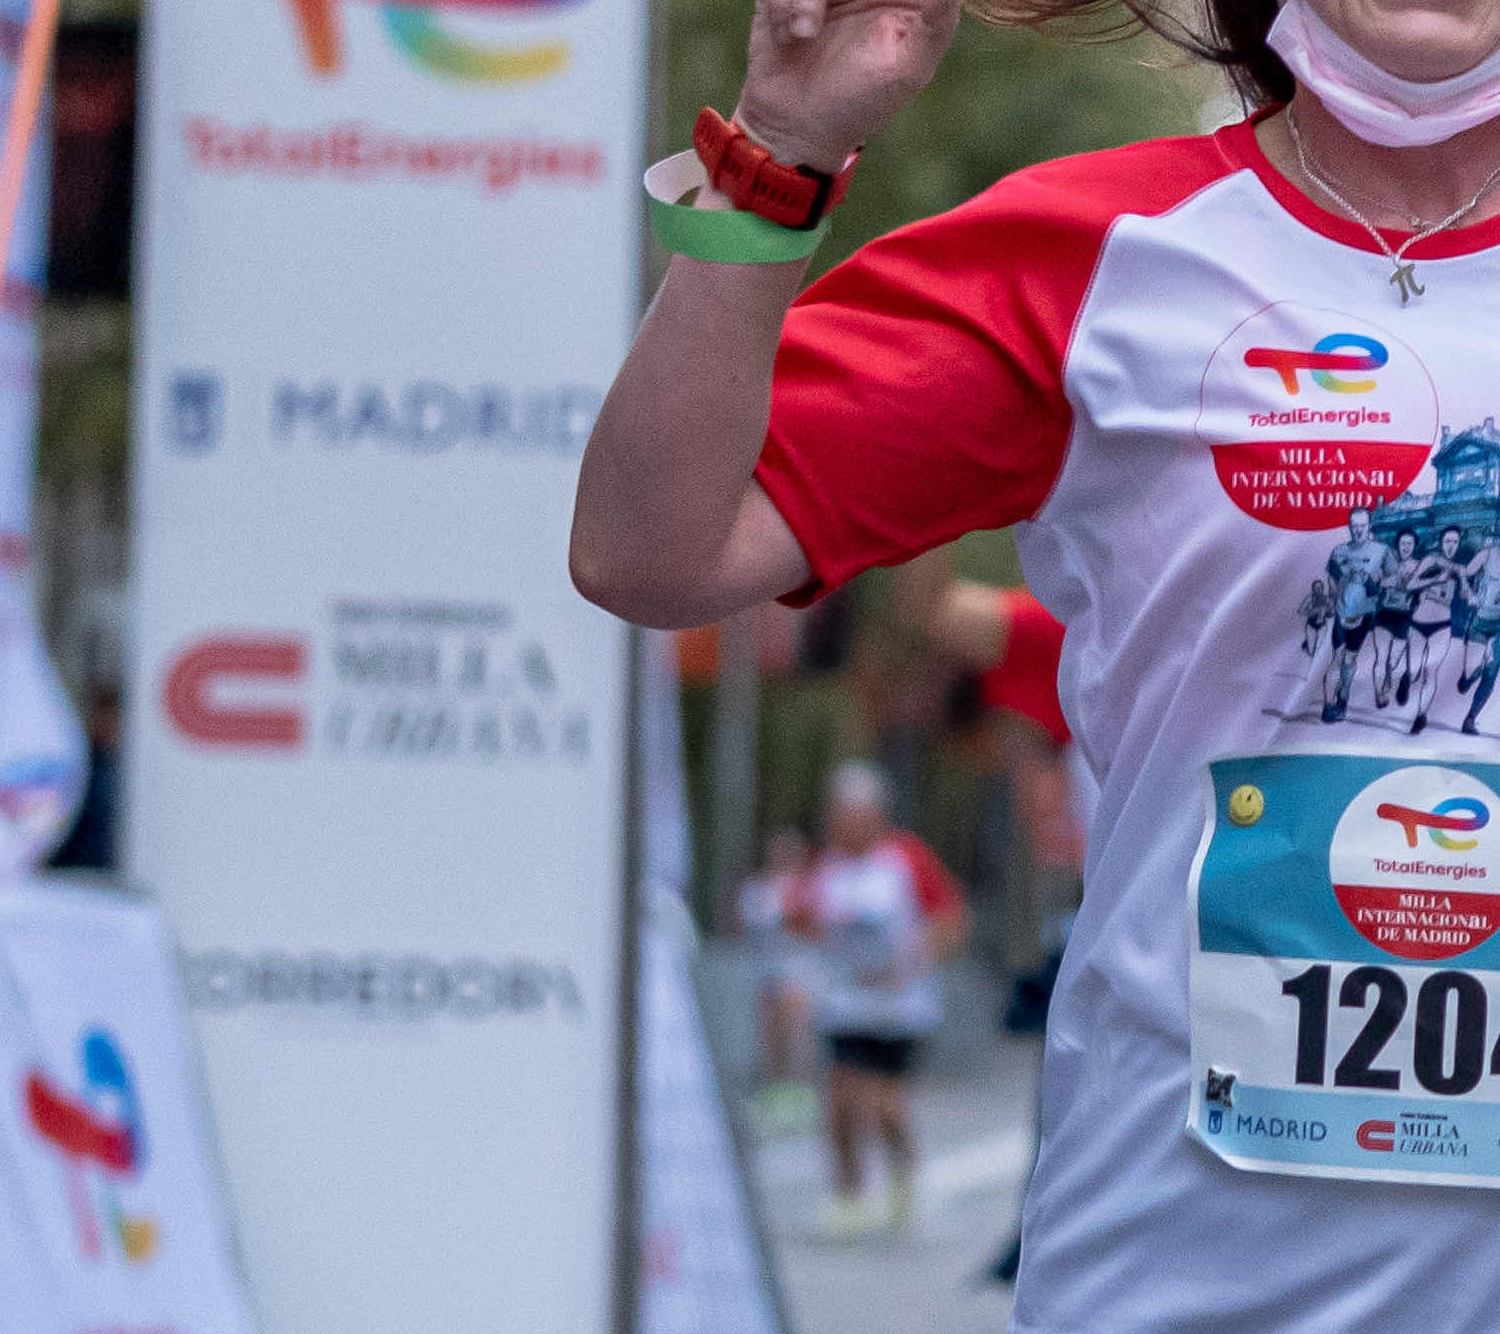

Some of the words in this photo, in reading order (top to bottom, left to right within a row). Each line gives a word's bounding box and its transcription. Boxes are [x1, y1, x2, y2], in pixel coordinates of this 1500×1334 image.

[184, 116, 605, 198] TotalEnergies
[1249, 407, 1392, 428] TotalEnergies
[1280, 447, 1346, 465] MILLA
[1252, 492, 1281, 509] DE
[1287, 490, 1373, 508] MADRID
[1374, 858, 1488, 881] TotalEnergies
[1399, 894, 1452, 911] MILLA
[1376, 926, 1399, 942] DE
[1404, 928, 1471, 945] MADRID
[1237, 1114, 1328, 1142] MADRID
[1401, 1121, 1460, 1140] MILLA
